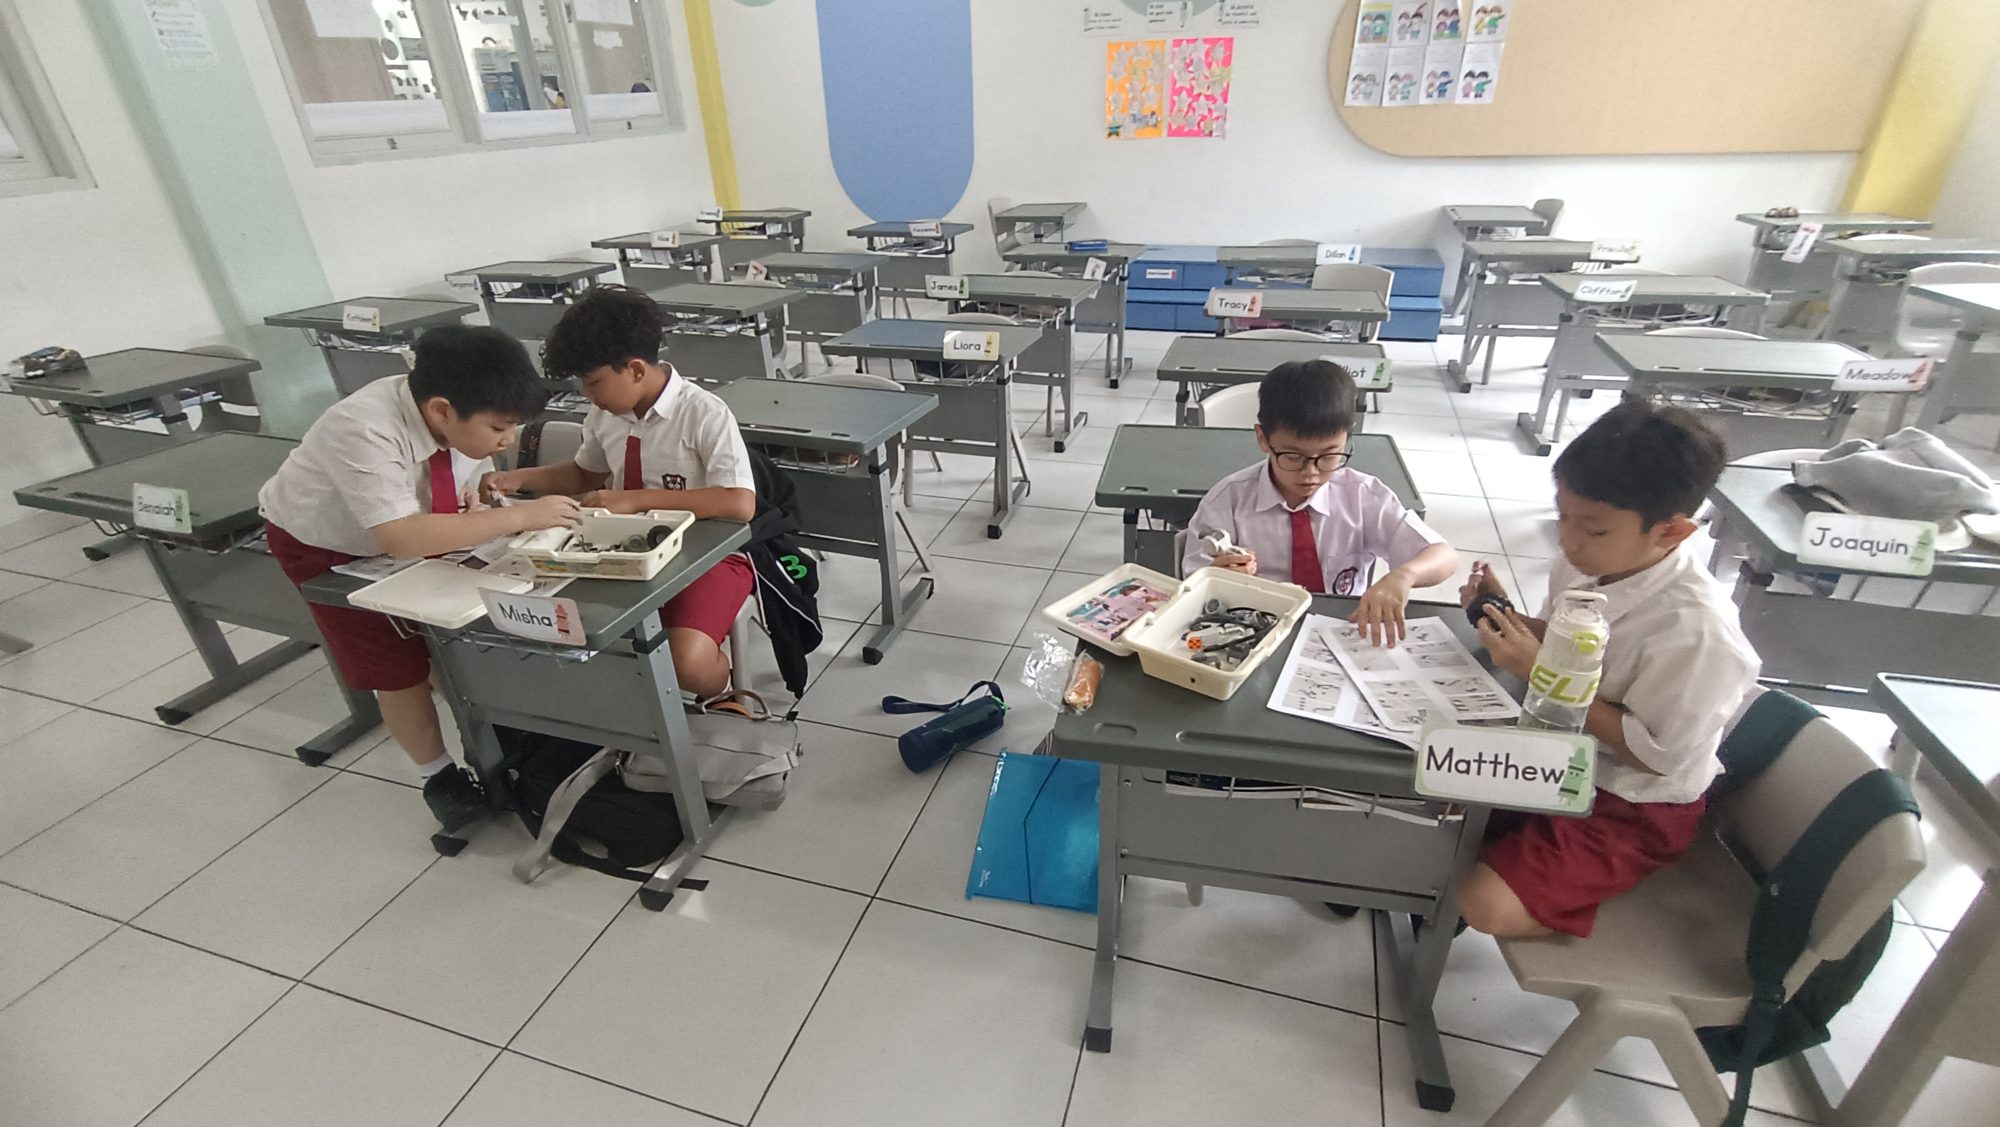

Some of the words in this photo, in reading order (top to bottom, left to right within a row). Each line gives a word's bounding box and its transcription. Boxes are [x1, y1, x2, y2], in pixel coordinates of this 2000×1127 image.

[931, 281, 958, 291] James
[1218, 297, 1249, 311] Tracy
[953, 339, 981, 351] Liora
[1845, 368, 1912, 380] Meadow
[138, 496, 176, 516] Benaiah
[1809, 527, 1908, 557] Joaquin
[498, 601, 553, 627] Misha
[1425, 745, 1565, 786] Matthew
